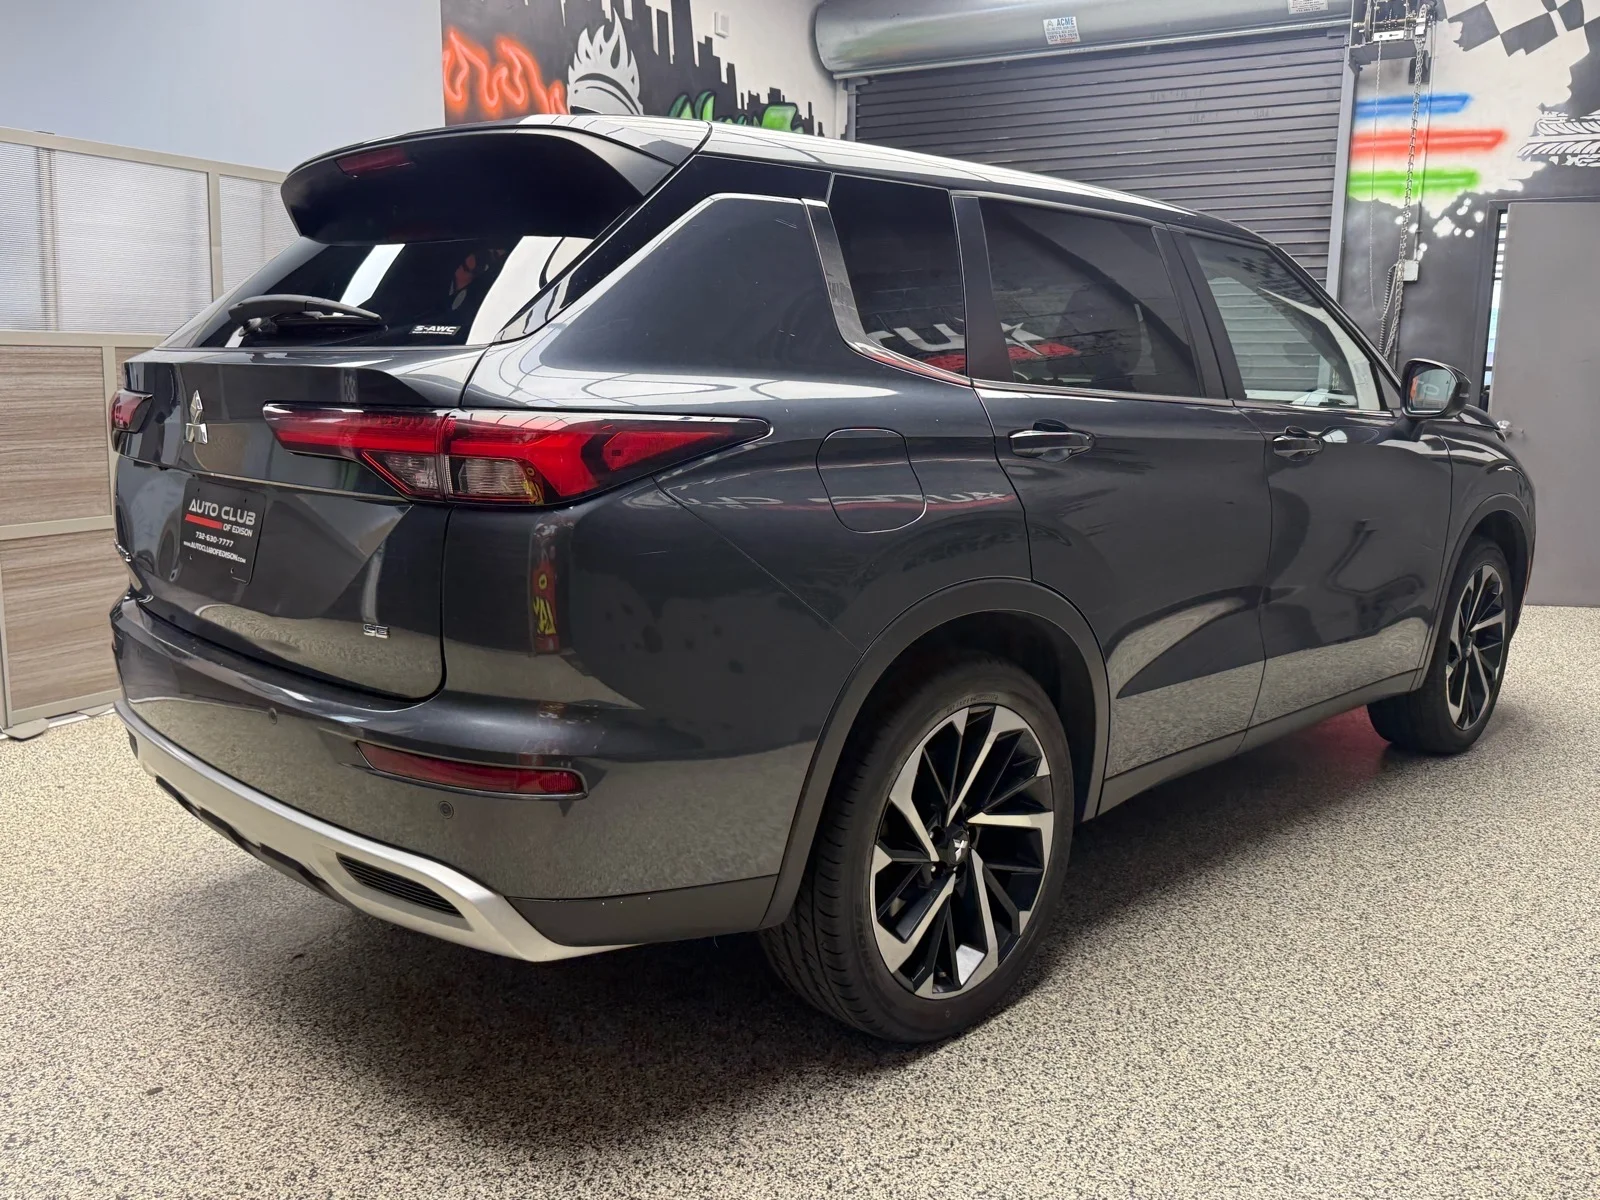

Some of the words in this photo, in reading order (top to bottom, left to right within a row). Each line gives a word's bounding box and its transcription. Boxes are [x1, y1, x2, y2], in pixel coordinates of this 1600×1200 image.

[1057, 18, 1074, 26] ACME
[189, 499, 219, 517] AUTO
[221, 506, 256, 525] CLUB
[223, 523, 231, 532] OF
[232, 526, 253, 537] EDISON
[195, 531, 234, 547] 732-630-7777
